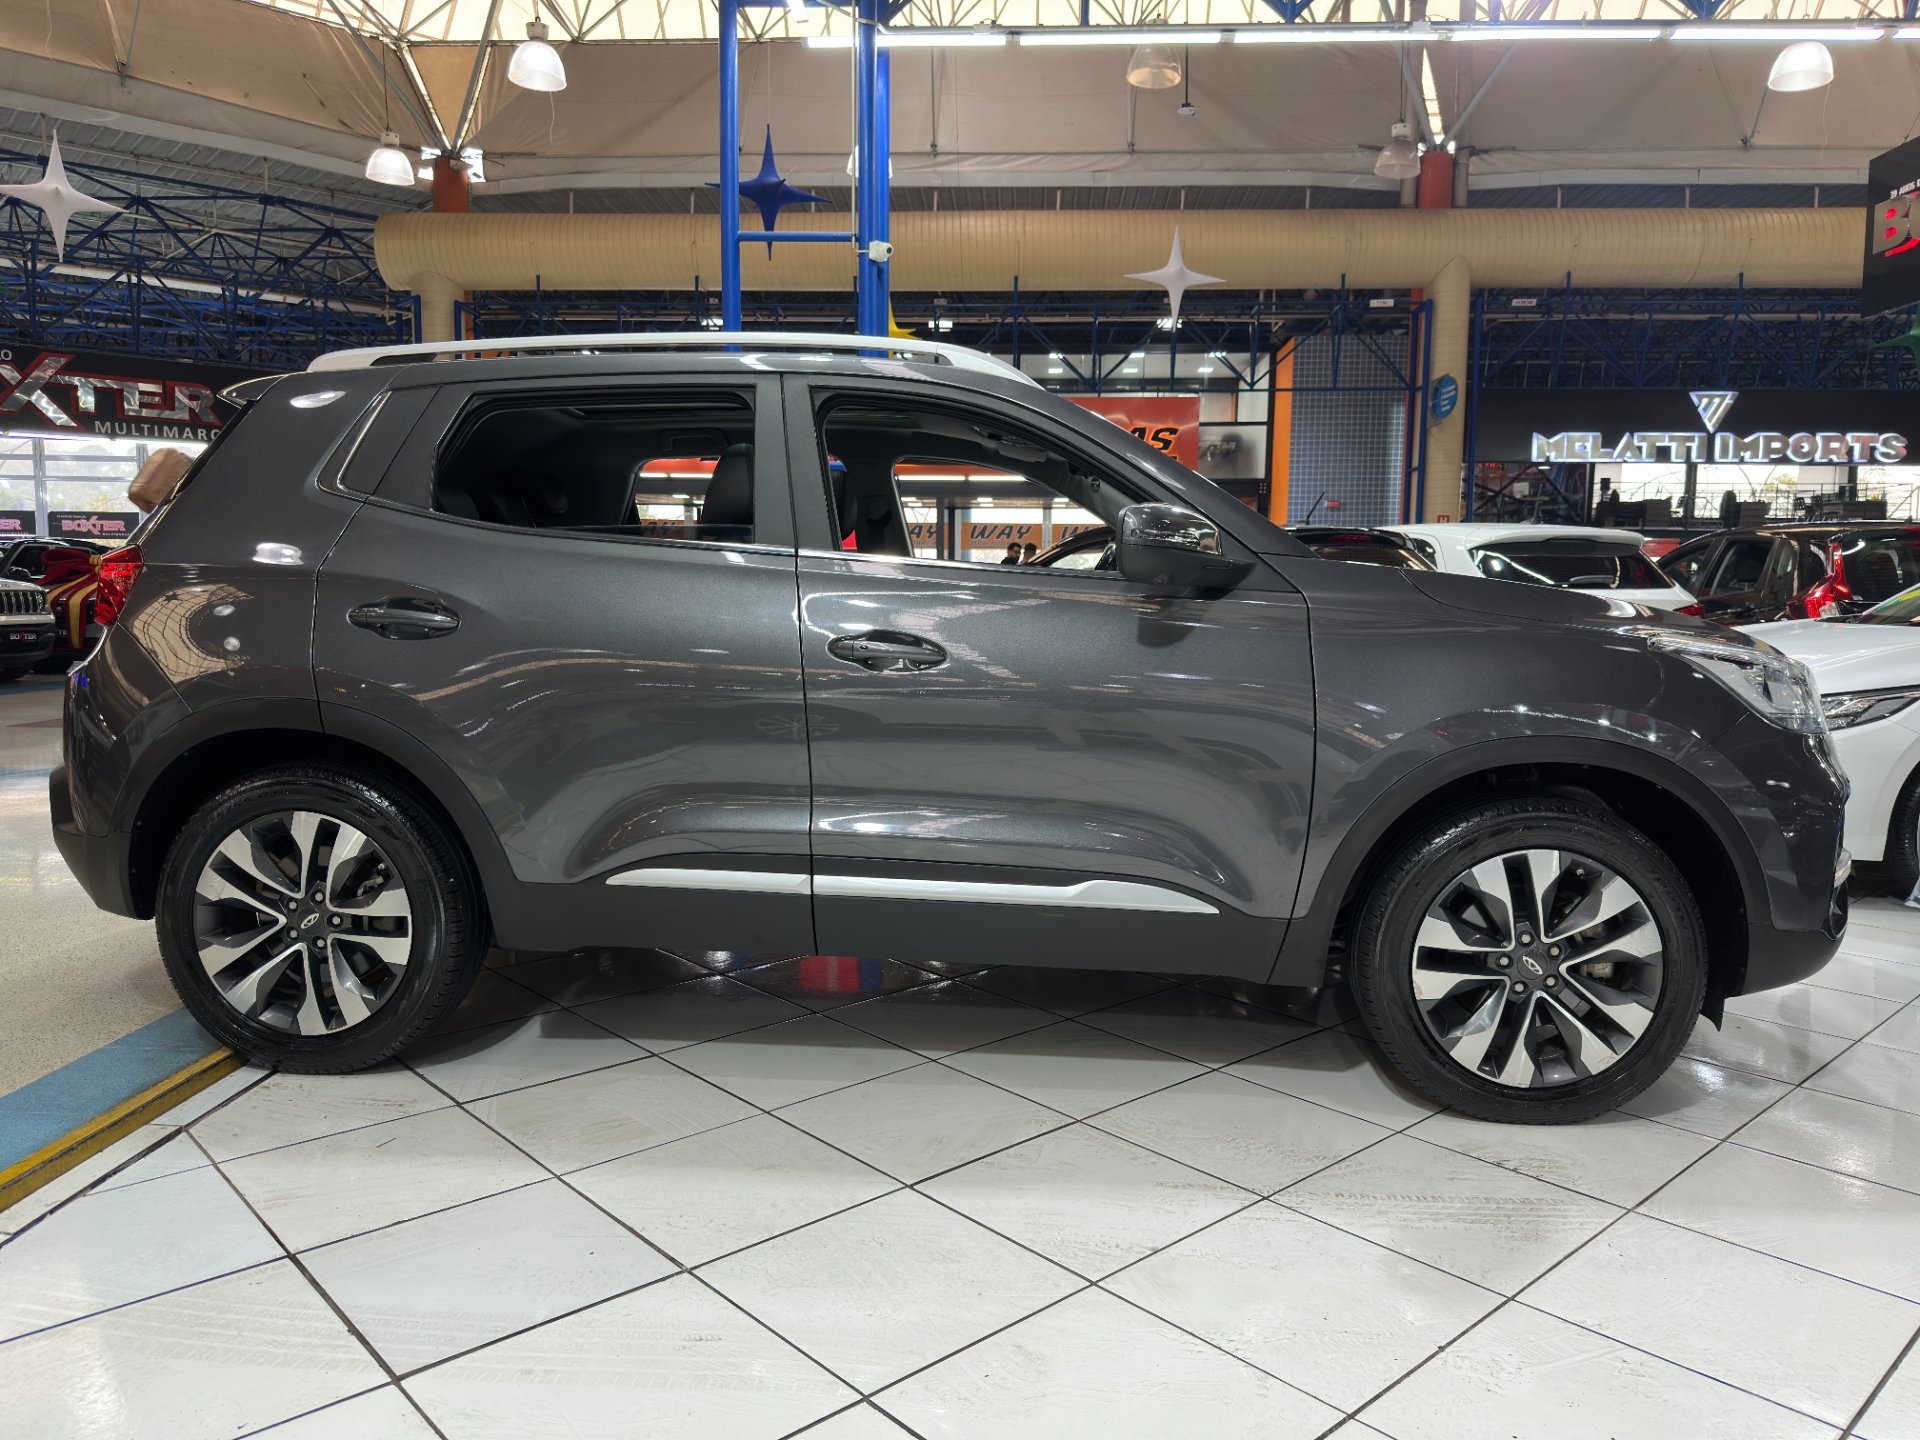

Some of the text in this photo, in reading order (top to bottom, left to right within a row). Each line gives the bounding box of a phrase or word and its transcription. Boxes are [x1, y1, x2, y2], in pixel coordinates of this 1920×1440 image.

[1531, 431, 1909, 463] MELATTI IMPORTS
[61, 515, 126, 535] BOXTER
[970, 525, 1032, 540] WAY
